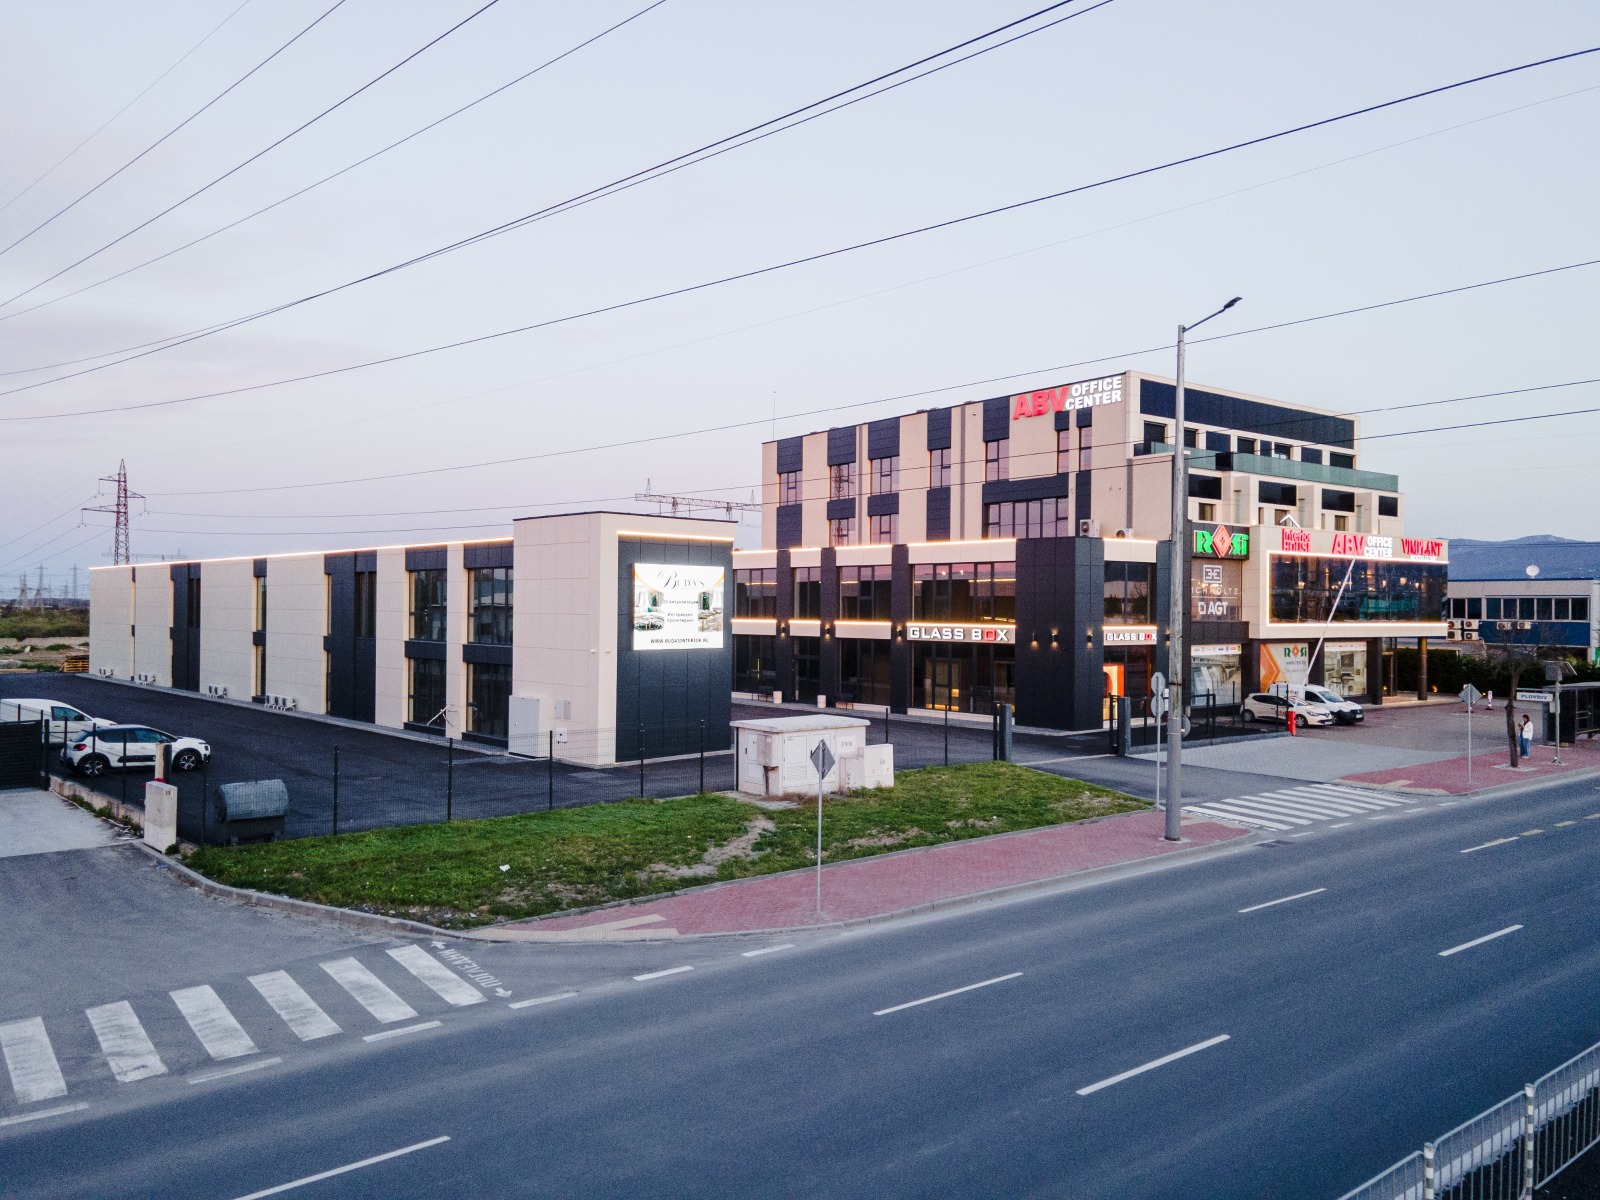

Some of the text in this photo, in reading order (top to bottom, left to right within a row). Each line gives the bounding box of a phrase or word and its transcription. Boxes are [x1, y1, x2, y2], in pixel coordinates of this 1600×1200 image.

[1071, 376, 1122, 396] OFFICE
[1013, 386, 1069, 420] ABV
[1065, 390, 1122, 411] CENTER
[1331, 533, 1366, 556] ABV
[1367, 536, 1393, 547] OFFICE
[1364, 547, 1392, 558] CENTER
[1191, 586, 1238, 595] ICHHOLTZ
[1208, 601, 1228, 615] AGT
[909, 627, 1009, 642] GLASS BOX
[1106, 632, 1157, 641] GLASS BOX
